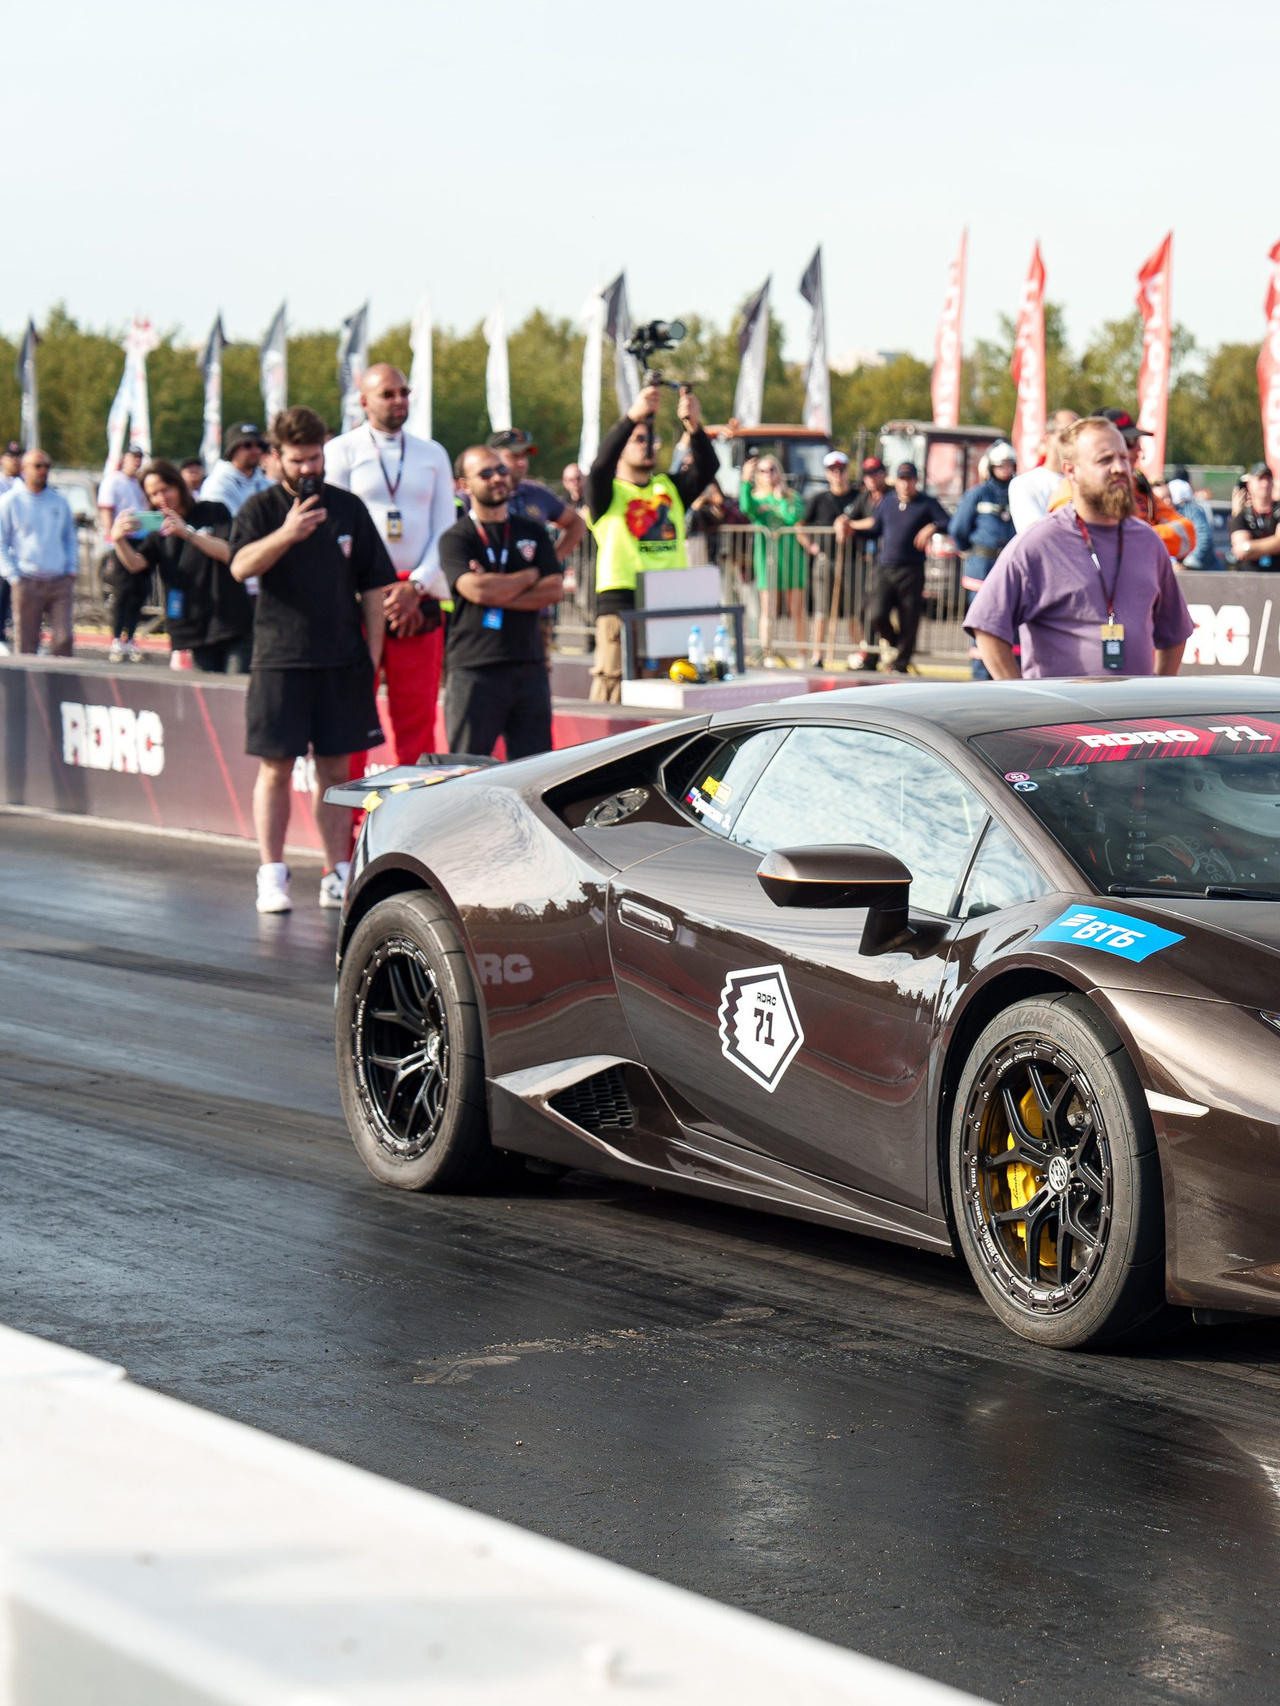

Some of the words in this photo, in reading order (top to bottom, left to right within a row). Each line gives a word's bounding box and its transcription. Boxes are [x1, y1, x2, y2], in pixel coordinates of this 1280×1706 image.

[1182, 603, 1250, 667] RC
[60, 701, 166, 777] RDRC
[1076, 729, 1199, 748] RDRC
[1208, 725, 1273, 742] 71
[1071, 920, 1147, 948] ВТБ
[474, 952, 534, 985] RC
[757, 991, 777, 1006] RDRC
[754, 1007, 775, 1047] 71
